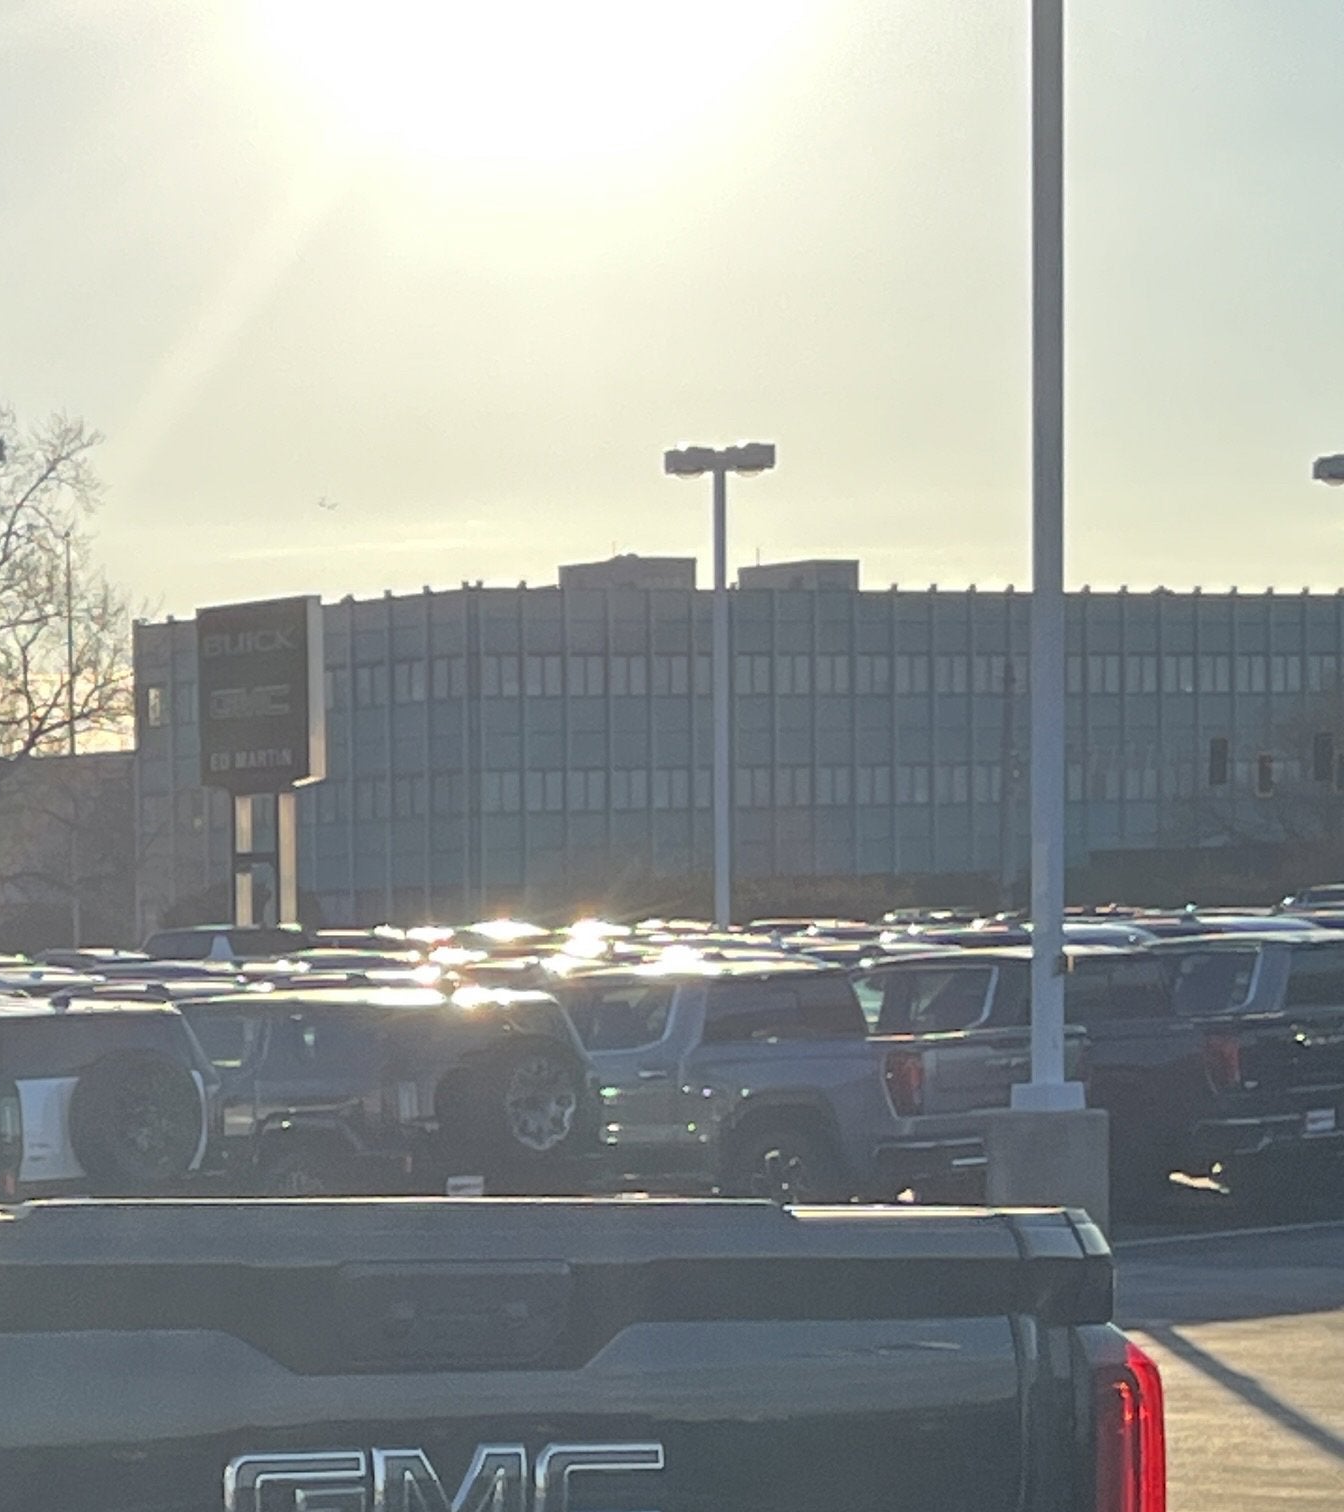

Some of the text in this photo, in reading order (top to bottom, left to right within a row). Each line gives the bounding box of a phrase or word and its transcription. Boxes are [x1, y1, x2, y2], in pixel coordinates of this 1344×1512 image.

[203, 627, 298, 658] BUICK
[210, 749, 293, 771] ED MARTIN
